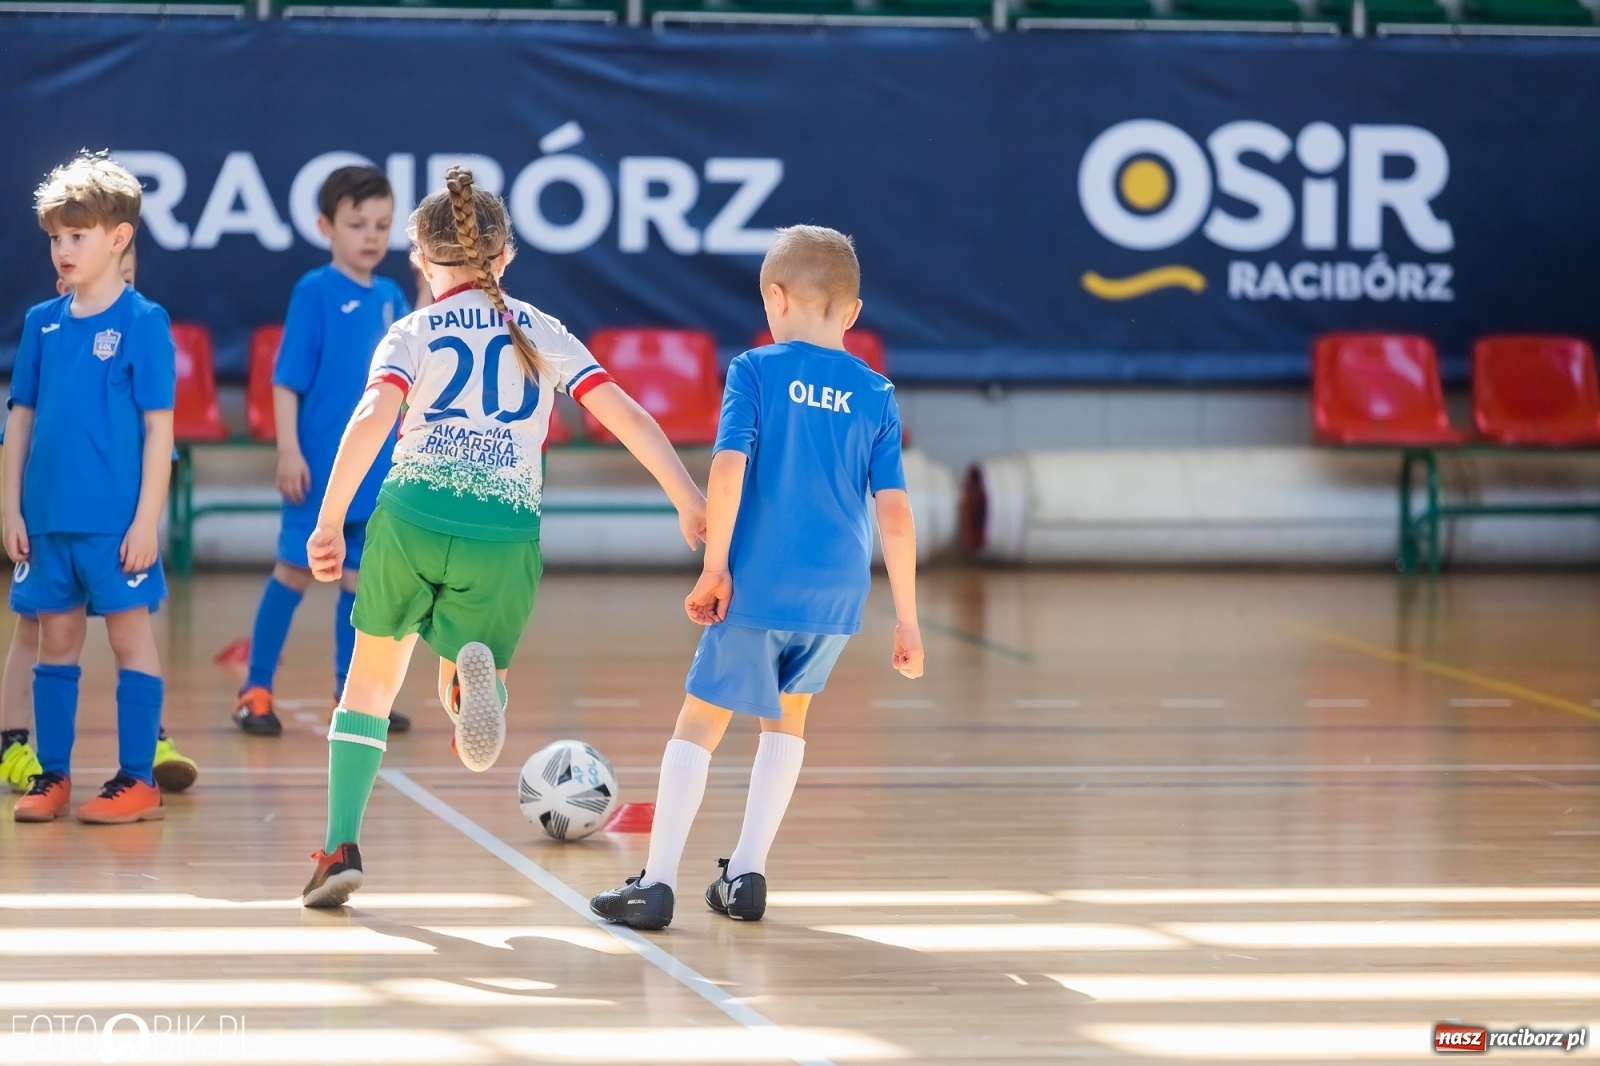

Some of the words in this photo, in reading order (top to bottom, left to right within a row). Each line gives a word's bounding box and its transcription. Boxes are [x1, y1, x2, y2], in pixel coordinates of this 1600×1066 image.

[1227, 252, 1455, 301] RACIBÓRZ
[424, 334, 540, 424] 20
[788, 380, 853, 413] OLEK
